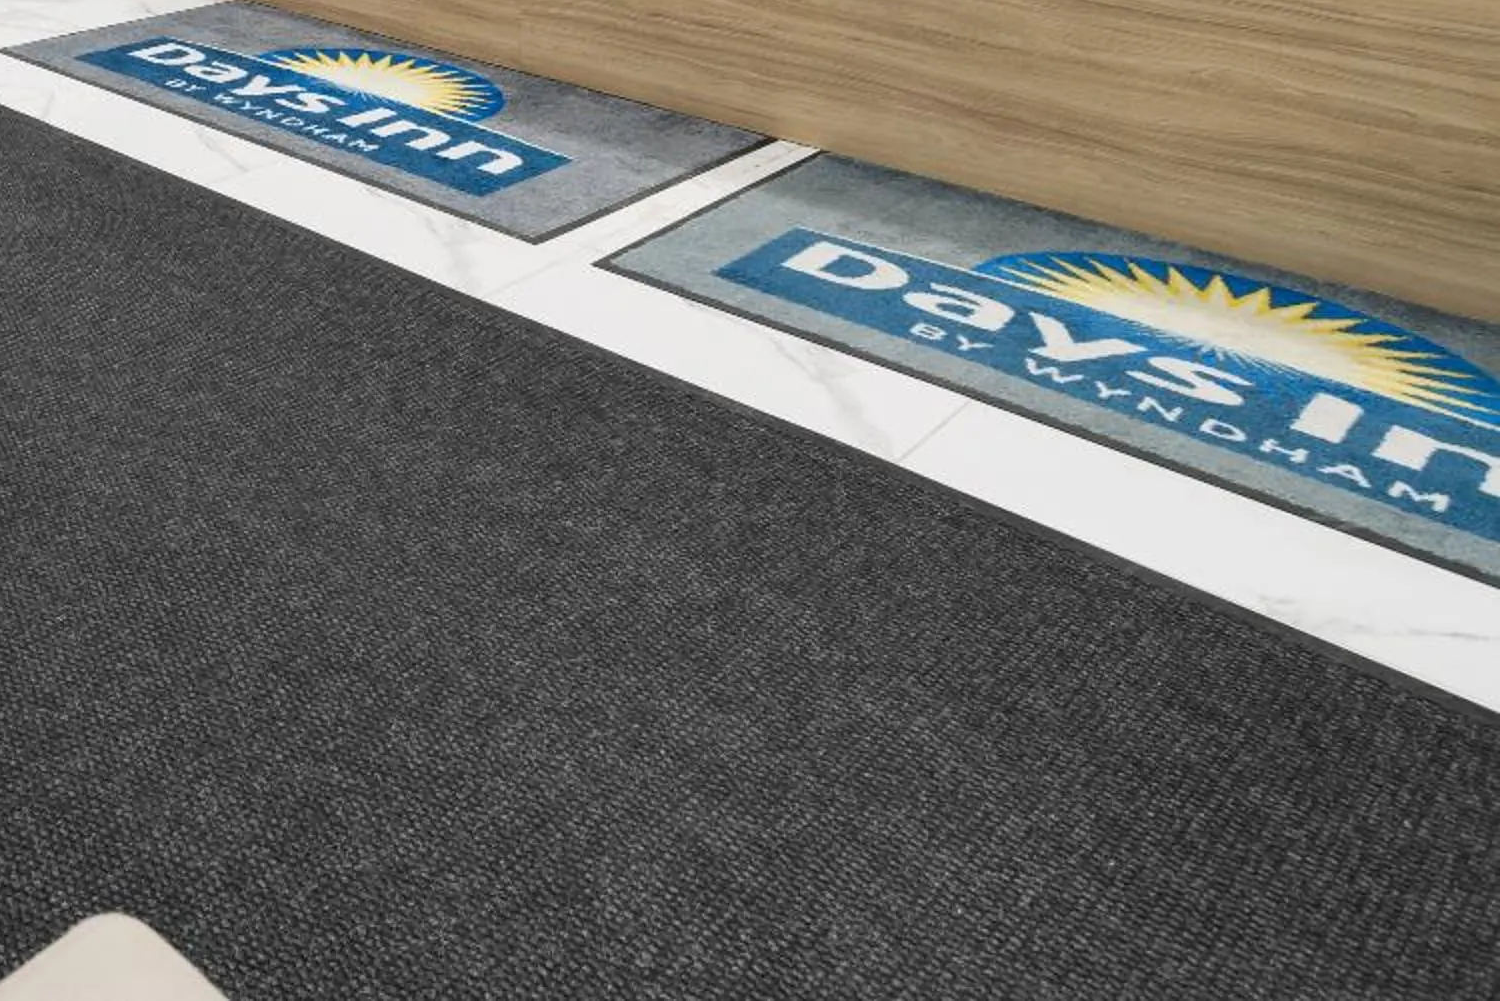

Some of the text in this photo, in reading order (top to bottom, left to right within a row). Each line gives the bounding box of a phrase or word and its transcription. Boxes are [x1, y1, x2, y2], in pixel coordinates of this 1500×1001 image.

[127, 42, 524, 175] Days Inn
[164, 78, 380, 151] BY WYNDHAM
[781, 240, 1255, 407] Days
[909, 322, 1451, 513] BY WYNDHAM
